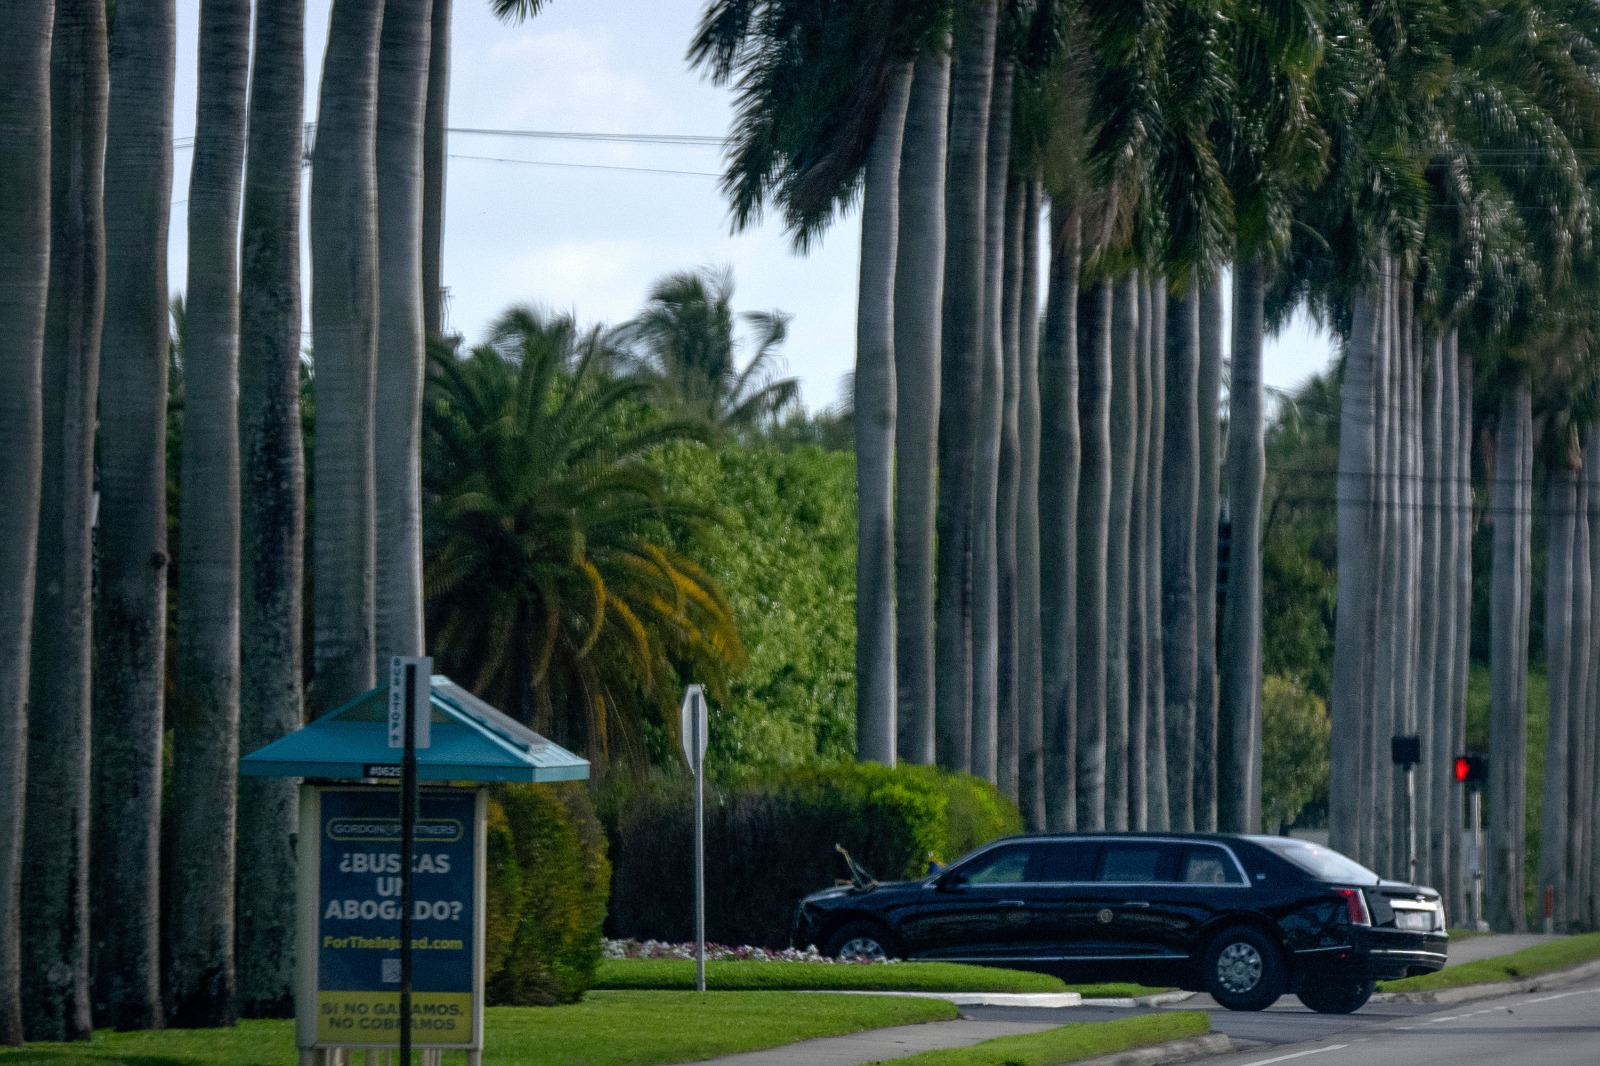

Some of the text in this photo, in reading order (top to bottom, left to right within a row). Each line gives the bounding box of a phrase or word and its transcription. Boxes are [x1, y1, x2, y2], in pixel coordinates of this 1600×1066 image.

[391, 658, 401, 729] BUS STOP
[394, 825, 457, 835] PTNERS
[323, 936, 464, 950] ForTheInjued.com
[344, 1004, 368, 1015] NO
[330, 1018, 353, 1029] NO
